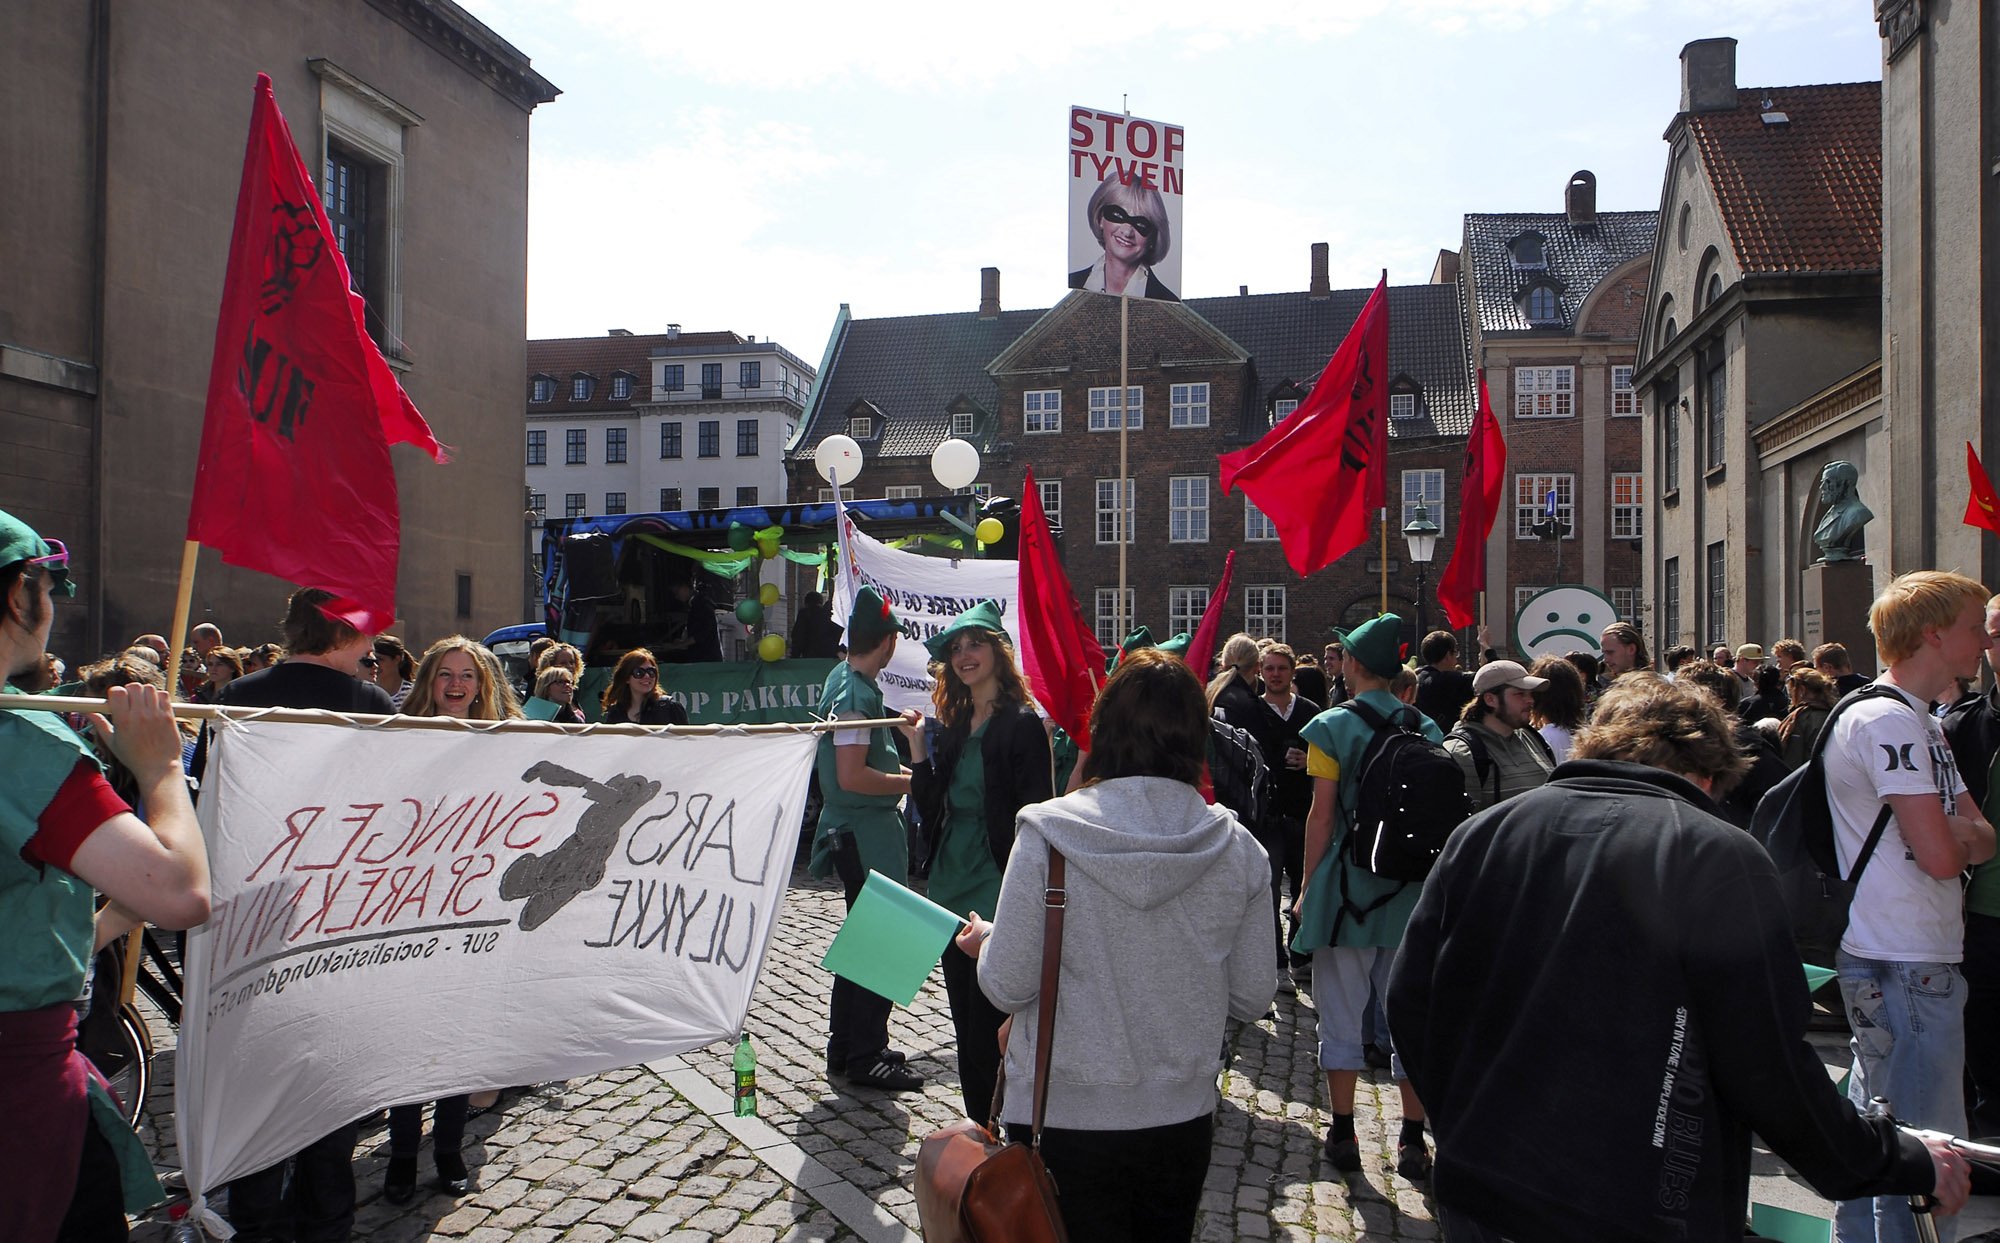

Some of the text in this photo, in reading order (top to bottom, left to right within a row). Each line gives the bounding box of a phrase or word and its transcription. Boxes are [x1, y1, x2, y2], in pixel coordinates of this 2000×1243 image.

[1071, 149, 1184, 196] TYVEN
[1673, 1029, 1685, 1042] IN
[1667, 1041, 1683, 1069] TUNE
